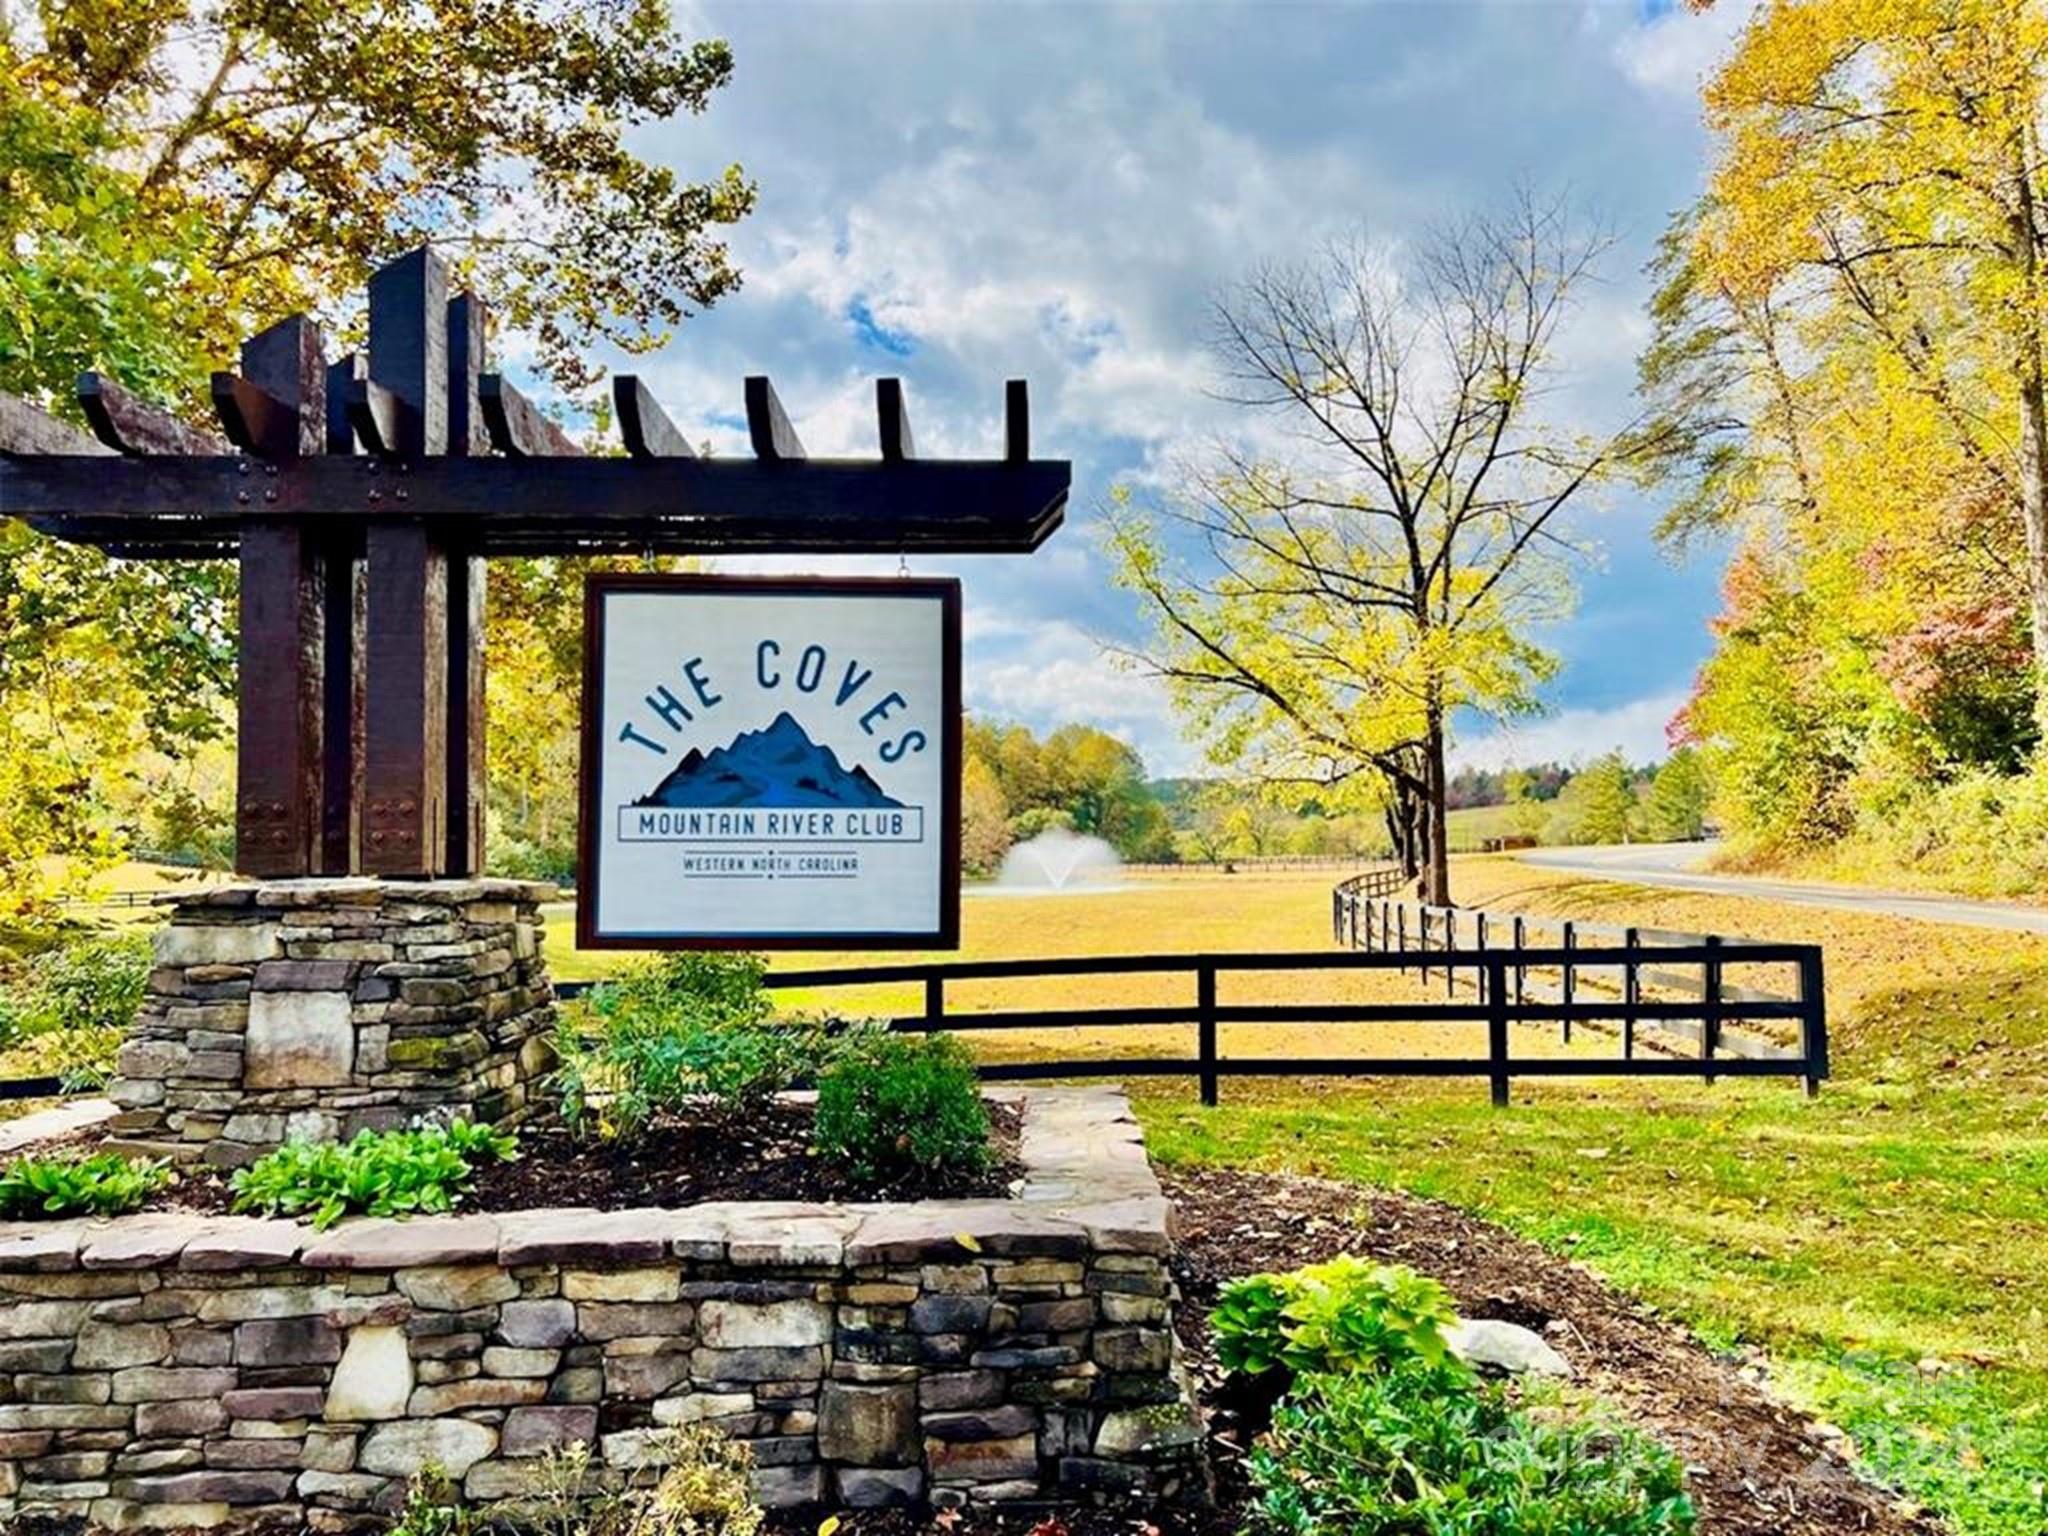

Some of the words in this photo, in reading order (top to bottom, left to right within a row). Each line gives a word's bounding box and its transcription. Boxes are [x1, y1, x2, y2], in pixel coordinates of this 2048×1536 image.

[619, 657, 723, 755] THE
[756, 639, 927, 764] COVES
[639, 812, 755, 835] MOUNTAIN
[767, 812, 834, 835] RIVER
[846, 812, 904, 836] CLUB
[683, 857, 745, 871] WESTERN
[751, 857, 792, 871] NORTH
[798, 857, 858, 871] CAROLINA
